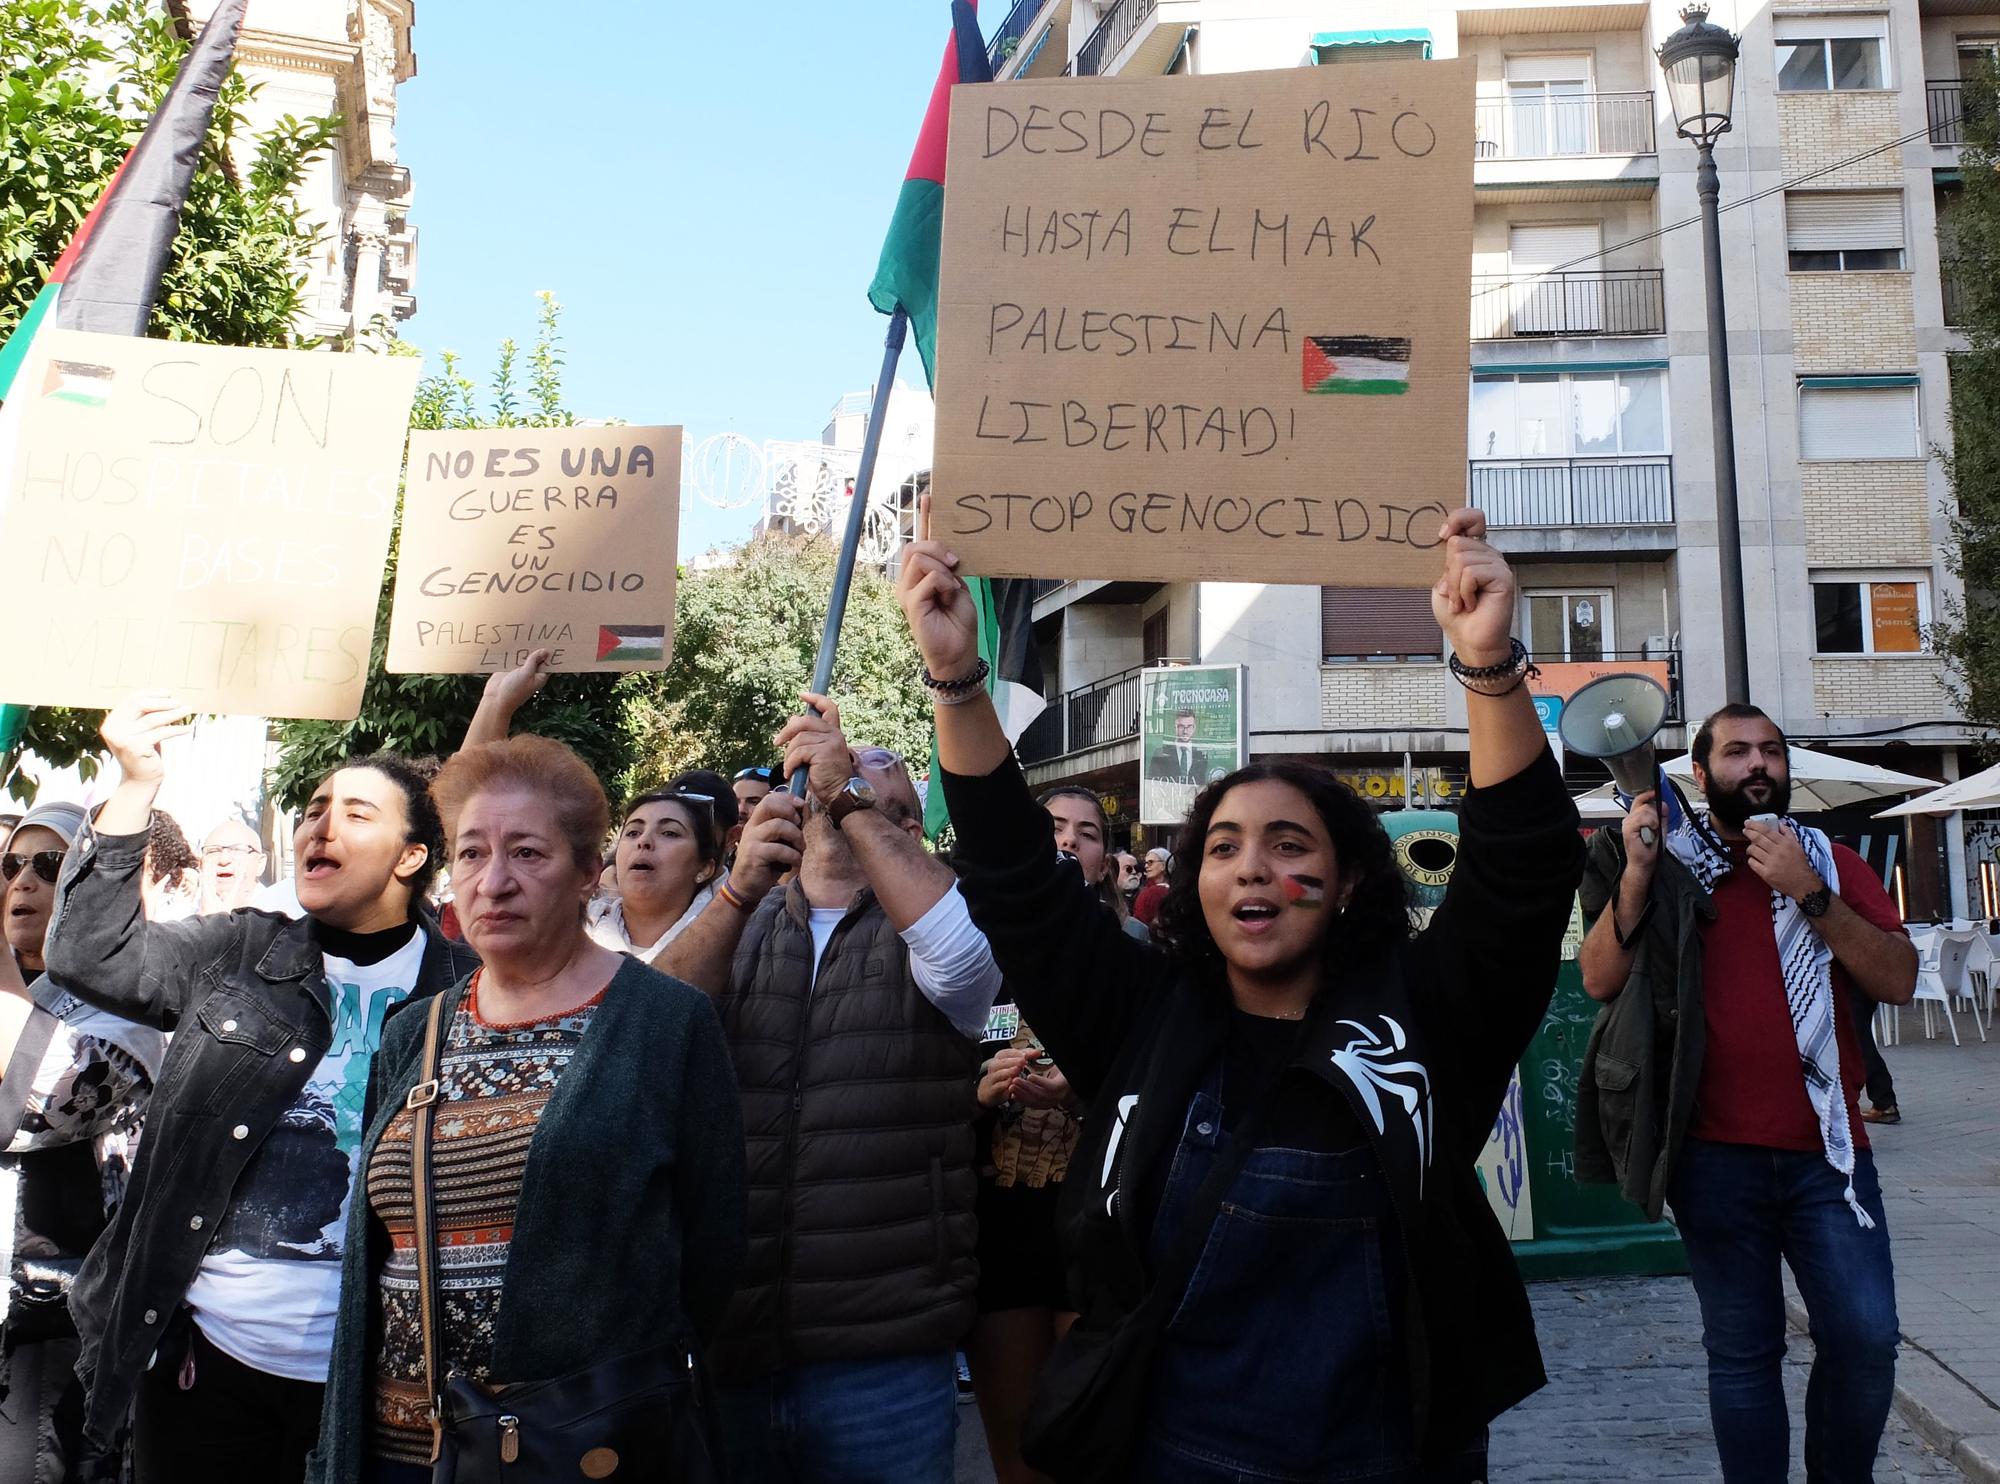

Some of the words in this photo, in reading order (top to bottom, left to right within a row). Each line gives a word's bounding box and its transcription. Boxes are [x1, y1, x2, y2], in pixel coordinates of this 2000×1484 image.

[982, 104, 1172, 159] DESDE
[1199, 106, 1264, 151] EL
[1002, 205, 1132, 261] HASTA
[1167, 207, 1235, 257] EL
[1251, 208, 1382, 267] MAR
[988, 303, 1292, 357] PALESTINA
[141, 361, 334, 449] SON
[975, 395, 1296, 460] LIBERTAD!
[426, 450, 475, 482] NO
[484, 448, 541, 478] ES
[560, 445, 655, 478] UNA
[449, 485, 618, 520] GUERRA
[952, 490, 1094, 535] STOP
[1108, 490, 1449, 550] GENOCIDIO
[507, 524, 557, 550] ES
[40, 529, 136, 588] NO
[176, 526, 345, 591] BASES
[511, 552, 551, 571] UN
[419, 566, 645, 598] GENOCIDIO
[416, 620, 574, 647] PALESTINA
[40, 615, 370, 691] MILITARES
[1172, 688, 1230, 704] TECNOCASA
[1404, 864, 1420, 879] DE
[982, 1027, 1016, 1040] ATTER
